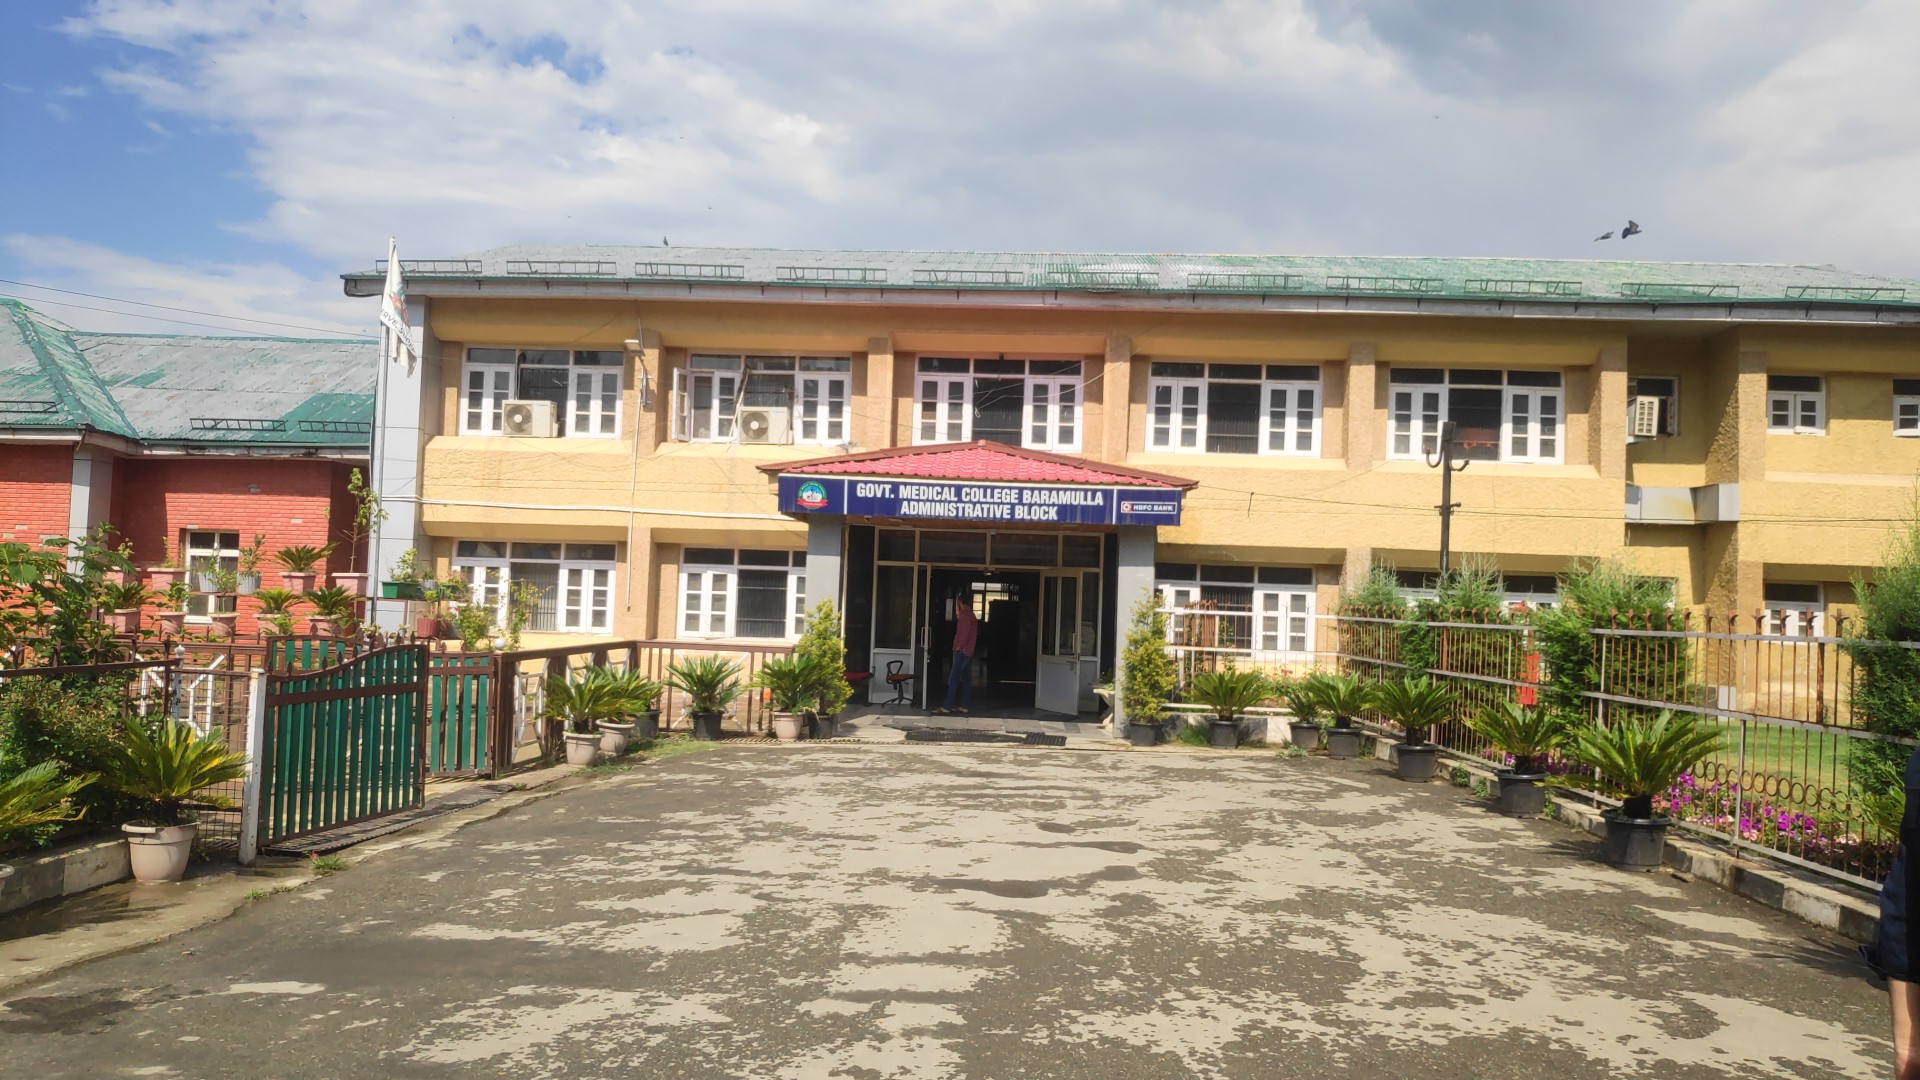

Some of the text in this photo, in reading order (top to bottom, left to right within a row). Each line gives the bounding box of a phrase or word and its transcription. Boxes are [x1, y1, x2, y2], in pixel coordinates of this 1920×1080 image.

[856, 483, 1104, 506] GOVT. MEDICAL COLLEGE BARAMULLA
[901, 501, 1058, 520] ADMINISTRATIVE BLOCK
